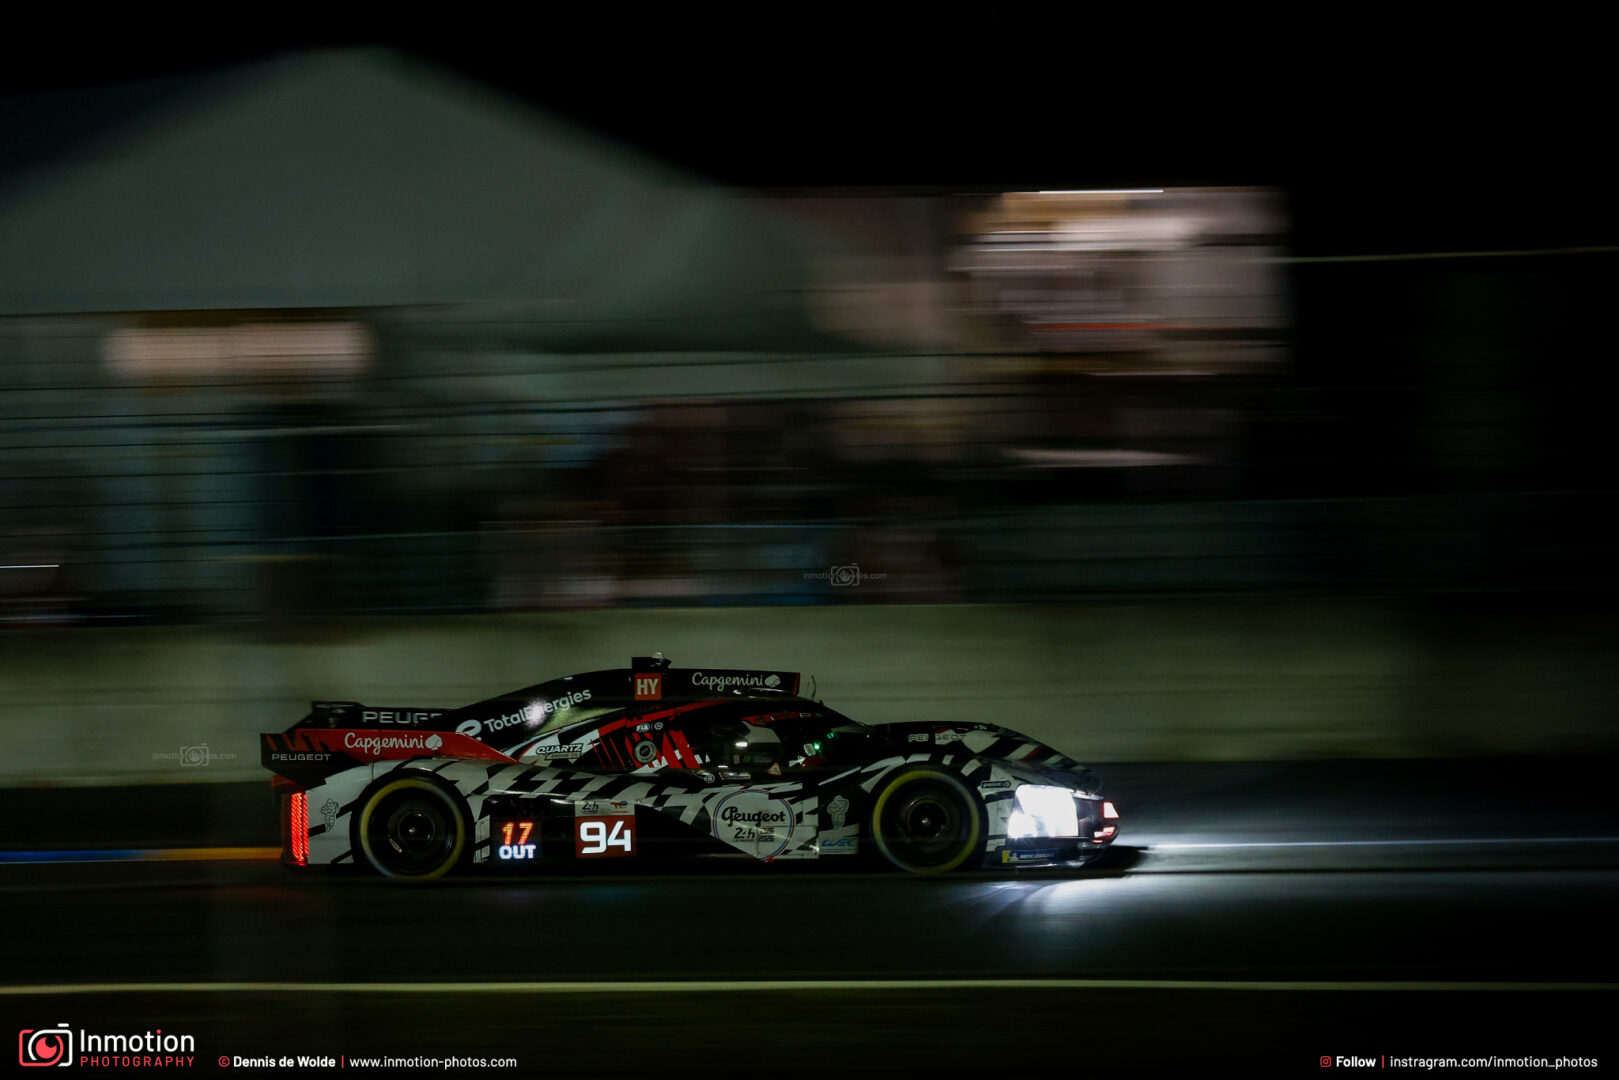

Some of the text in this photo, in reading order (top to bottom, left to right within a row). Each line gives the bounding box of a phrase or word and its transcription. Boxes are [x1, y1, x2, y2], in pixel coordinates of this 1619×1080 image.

[636, 678, 659, 695] HY
[692, 672, 763, 692] Capgemini
[361, 711, 443, 725] PEUG
[483, 689, 592, 733] TotalEergies
[344, 732, 424, 755] Capgemini
[536, 743, 582, 755] QUARTZ
[721, 806, 785, 827] Peugeot
[502, 823, 533, 845] 17
[580, 821, 631, 854] 94
[499, 845, 536, 859] OUT
